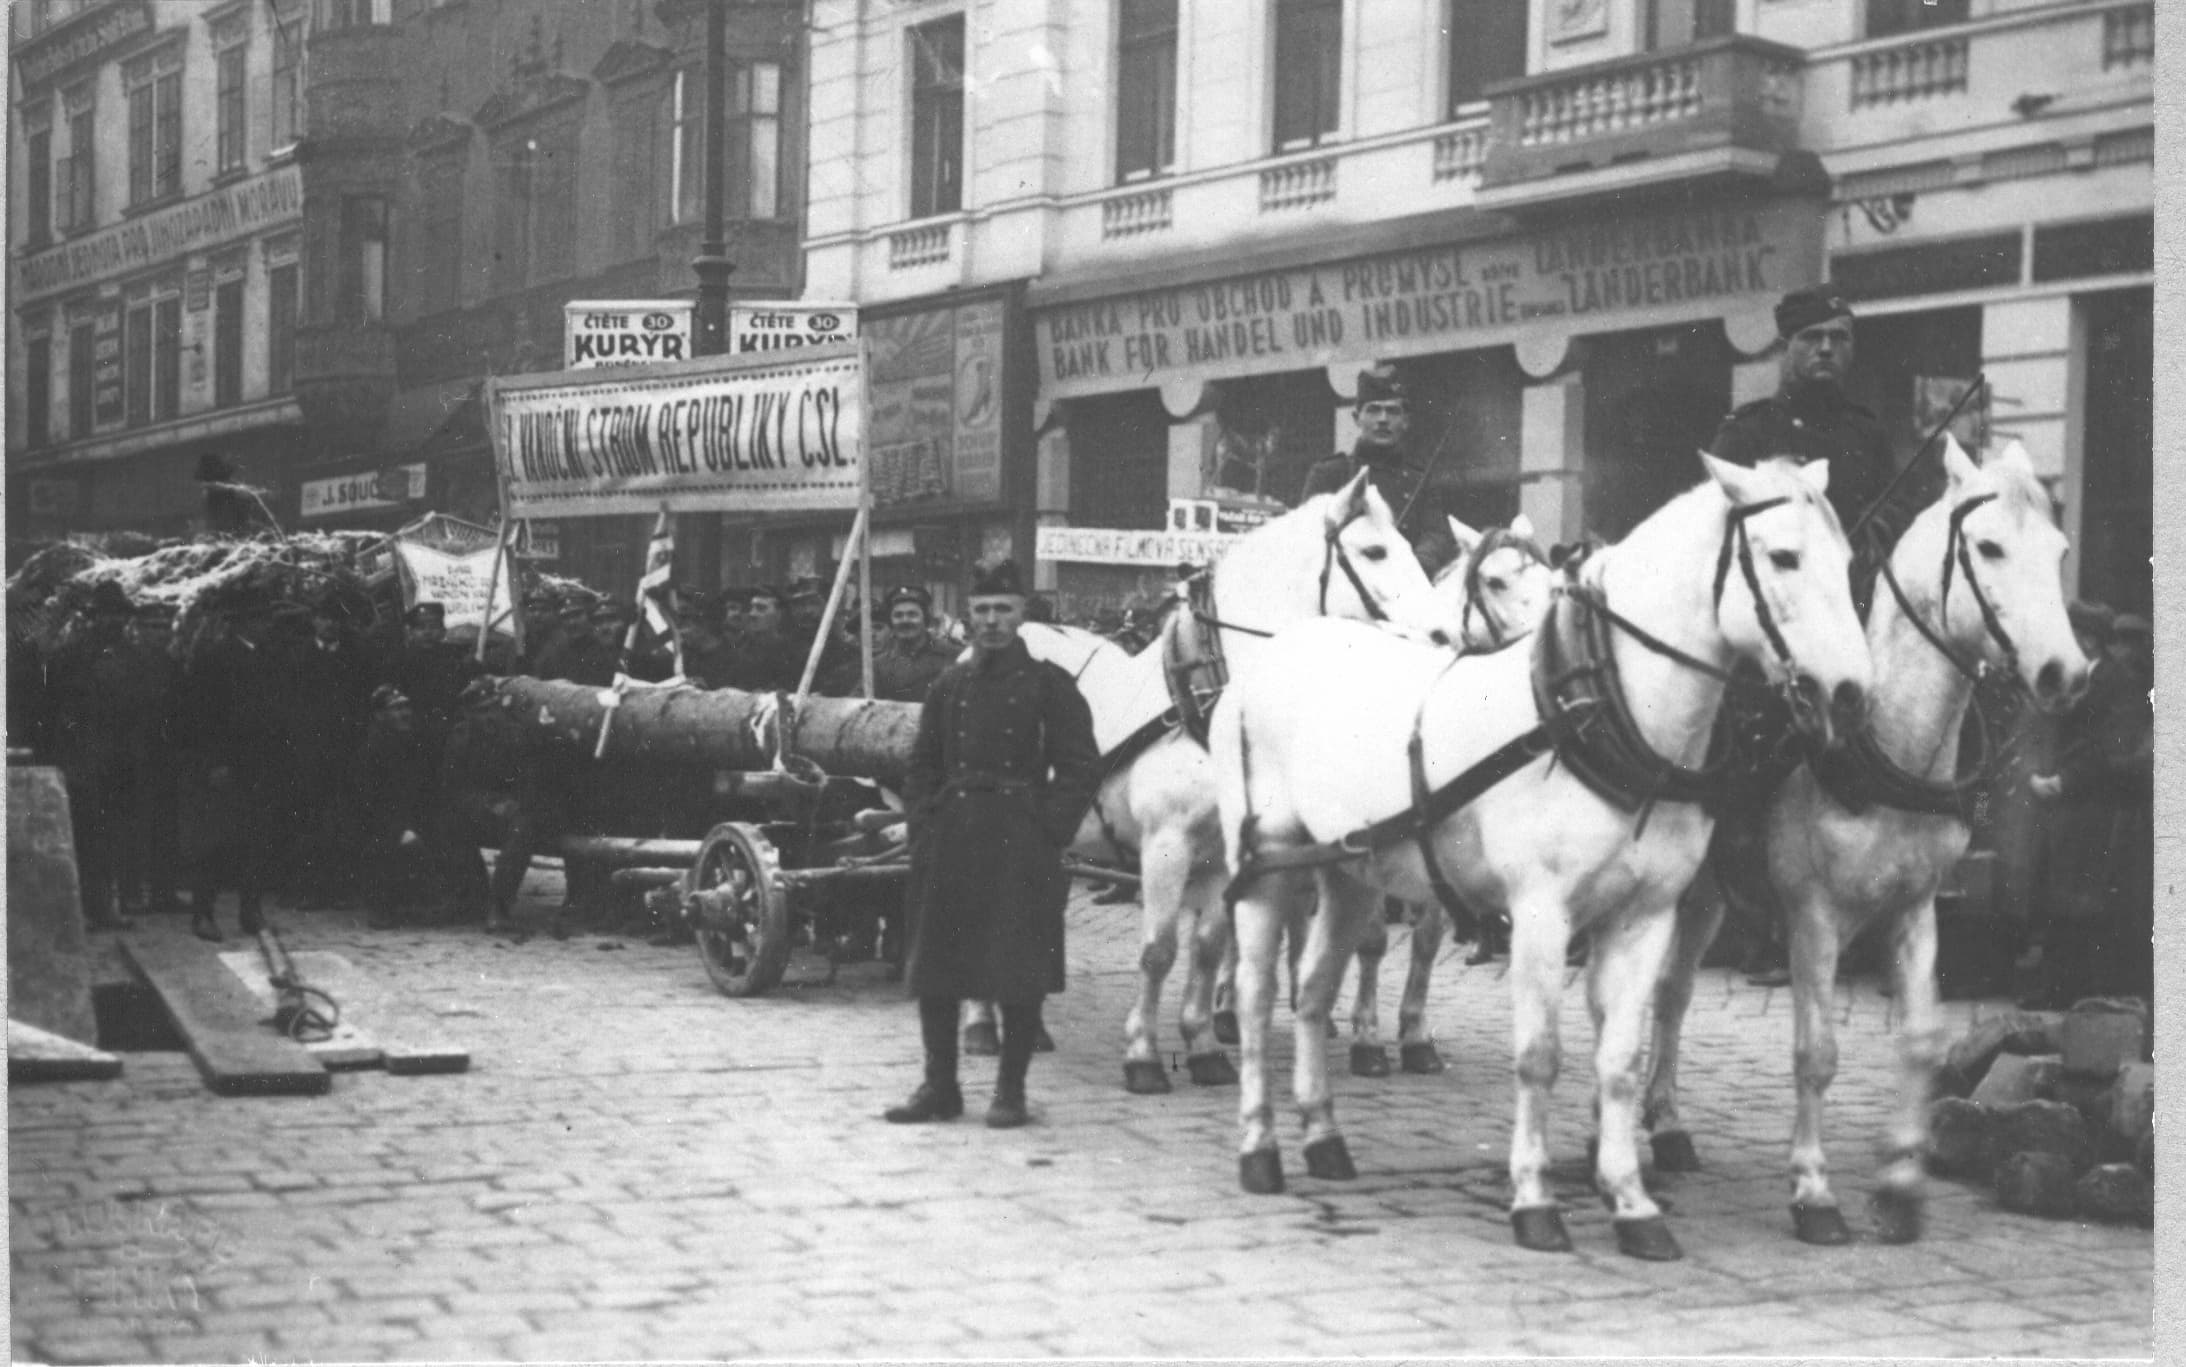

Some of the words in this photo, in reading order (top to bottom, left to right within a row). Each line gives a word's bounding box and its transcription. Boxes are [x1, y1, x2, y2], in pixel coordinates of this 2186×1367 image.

[583, 312, 630, 330] ČTĚTE
[750, 312, 795, 330] ČTĚTE
[1053, 303, 1122, 344] BANKA
[1138, 296, 1181, 328] PRO
[1197, 275, 1292, 323] OBCHOD
[1309, 270, 1326, 307] A
[1053, 342, 1111, 380] BANK
[1185, 316, 1283, 363] HANDEL
[1293, 308, 1344, 348] UND
[1362, 283, 1517, 341] INDUSTRIE
[586, 404, 659, 479] STROM
[658, 391, 791, 475] REPUBLIKY
